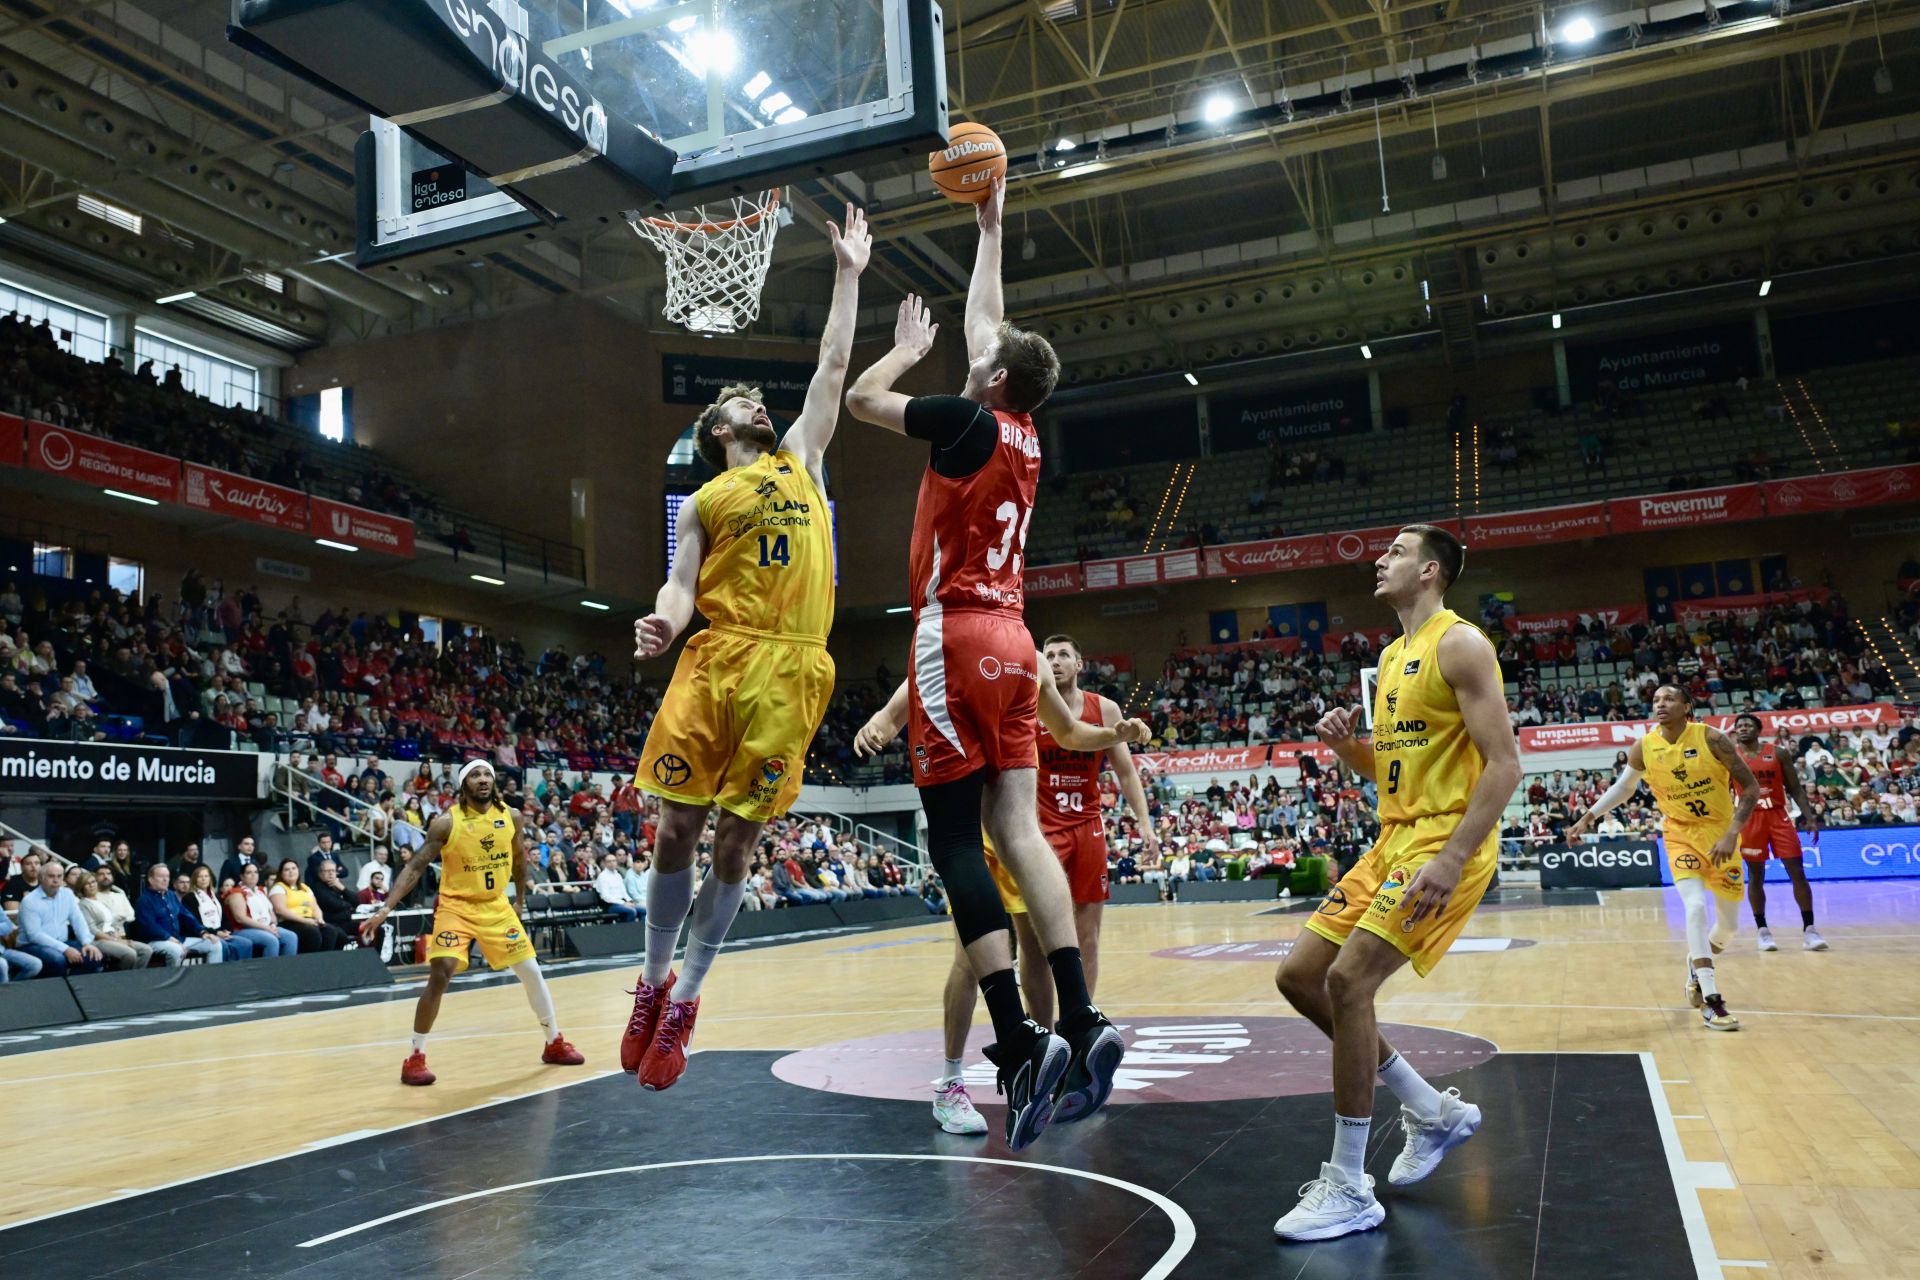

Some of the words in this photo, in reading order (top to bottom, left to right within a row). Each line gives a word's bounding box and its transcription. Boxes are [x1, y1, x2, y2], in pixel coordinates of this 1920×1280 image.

[445, 0, 608, 156] endesa
[943, 140, 996, 162] Wilson
[414, 181, 437, 196] liga
[414, 188, 464, 208] endesa
[1600, 342, 1720, 371] Ayuntamiento
[780, 380, 809, 391] Murci
[1618, 375, 1641, 390] de
[1645, 367, 1706, 386] Murcia
[1241, 399, 1344, 423] Ayuntamiento
[1279, 422, 1331, 438] Murcia
[121, 467, 134, 479] DE
[135, 471, 172, 488] MURCIA
[1640, 495, 1727, 517] Prevemur
[1489, 524, 1543, 536] ESTRELLA
[1551, 516, 1600, 529] LEVANTE
[1642, 514, 1693, 527] Prevención
[1702, 510, 1728, 519] Salud
[757, 534, 791, 567] 14
[1770, 707, 1882, 729] konery
[1529, 738, 1547, 747] tu
[1550, 736, 1600, 745] marca
[1, 750, 94, 780] miento
[100, 754, 131, 781] de
[137, 757, 216, 784] Murcia
[1168, 750, 1250, 767] realturf
[1388, 759, 1401, 795] 9
[1056, 792, 1083, 813] 20
[1542, 846, 1653, 869] endesa
[484, 871, 495, 891] 6
